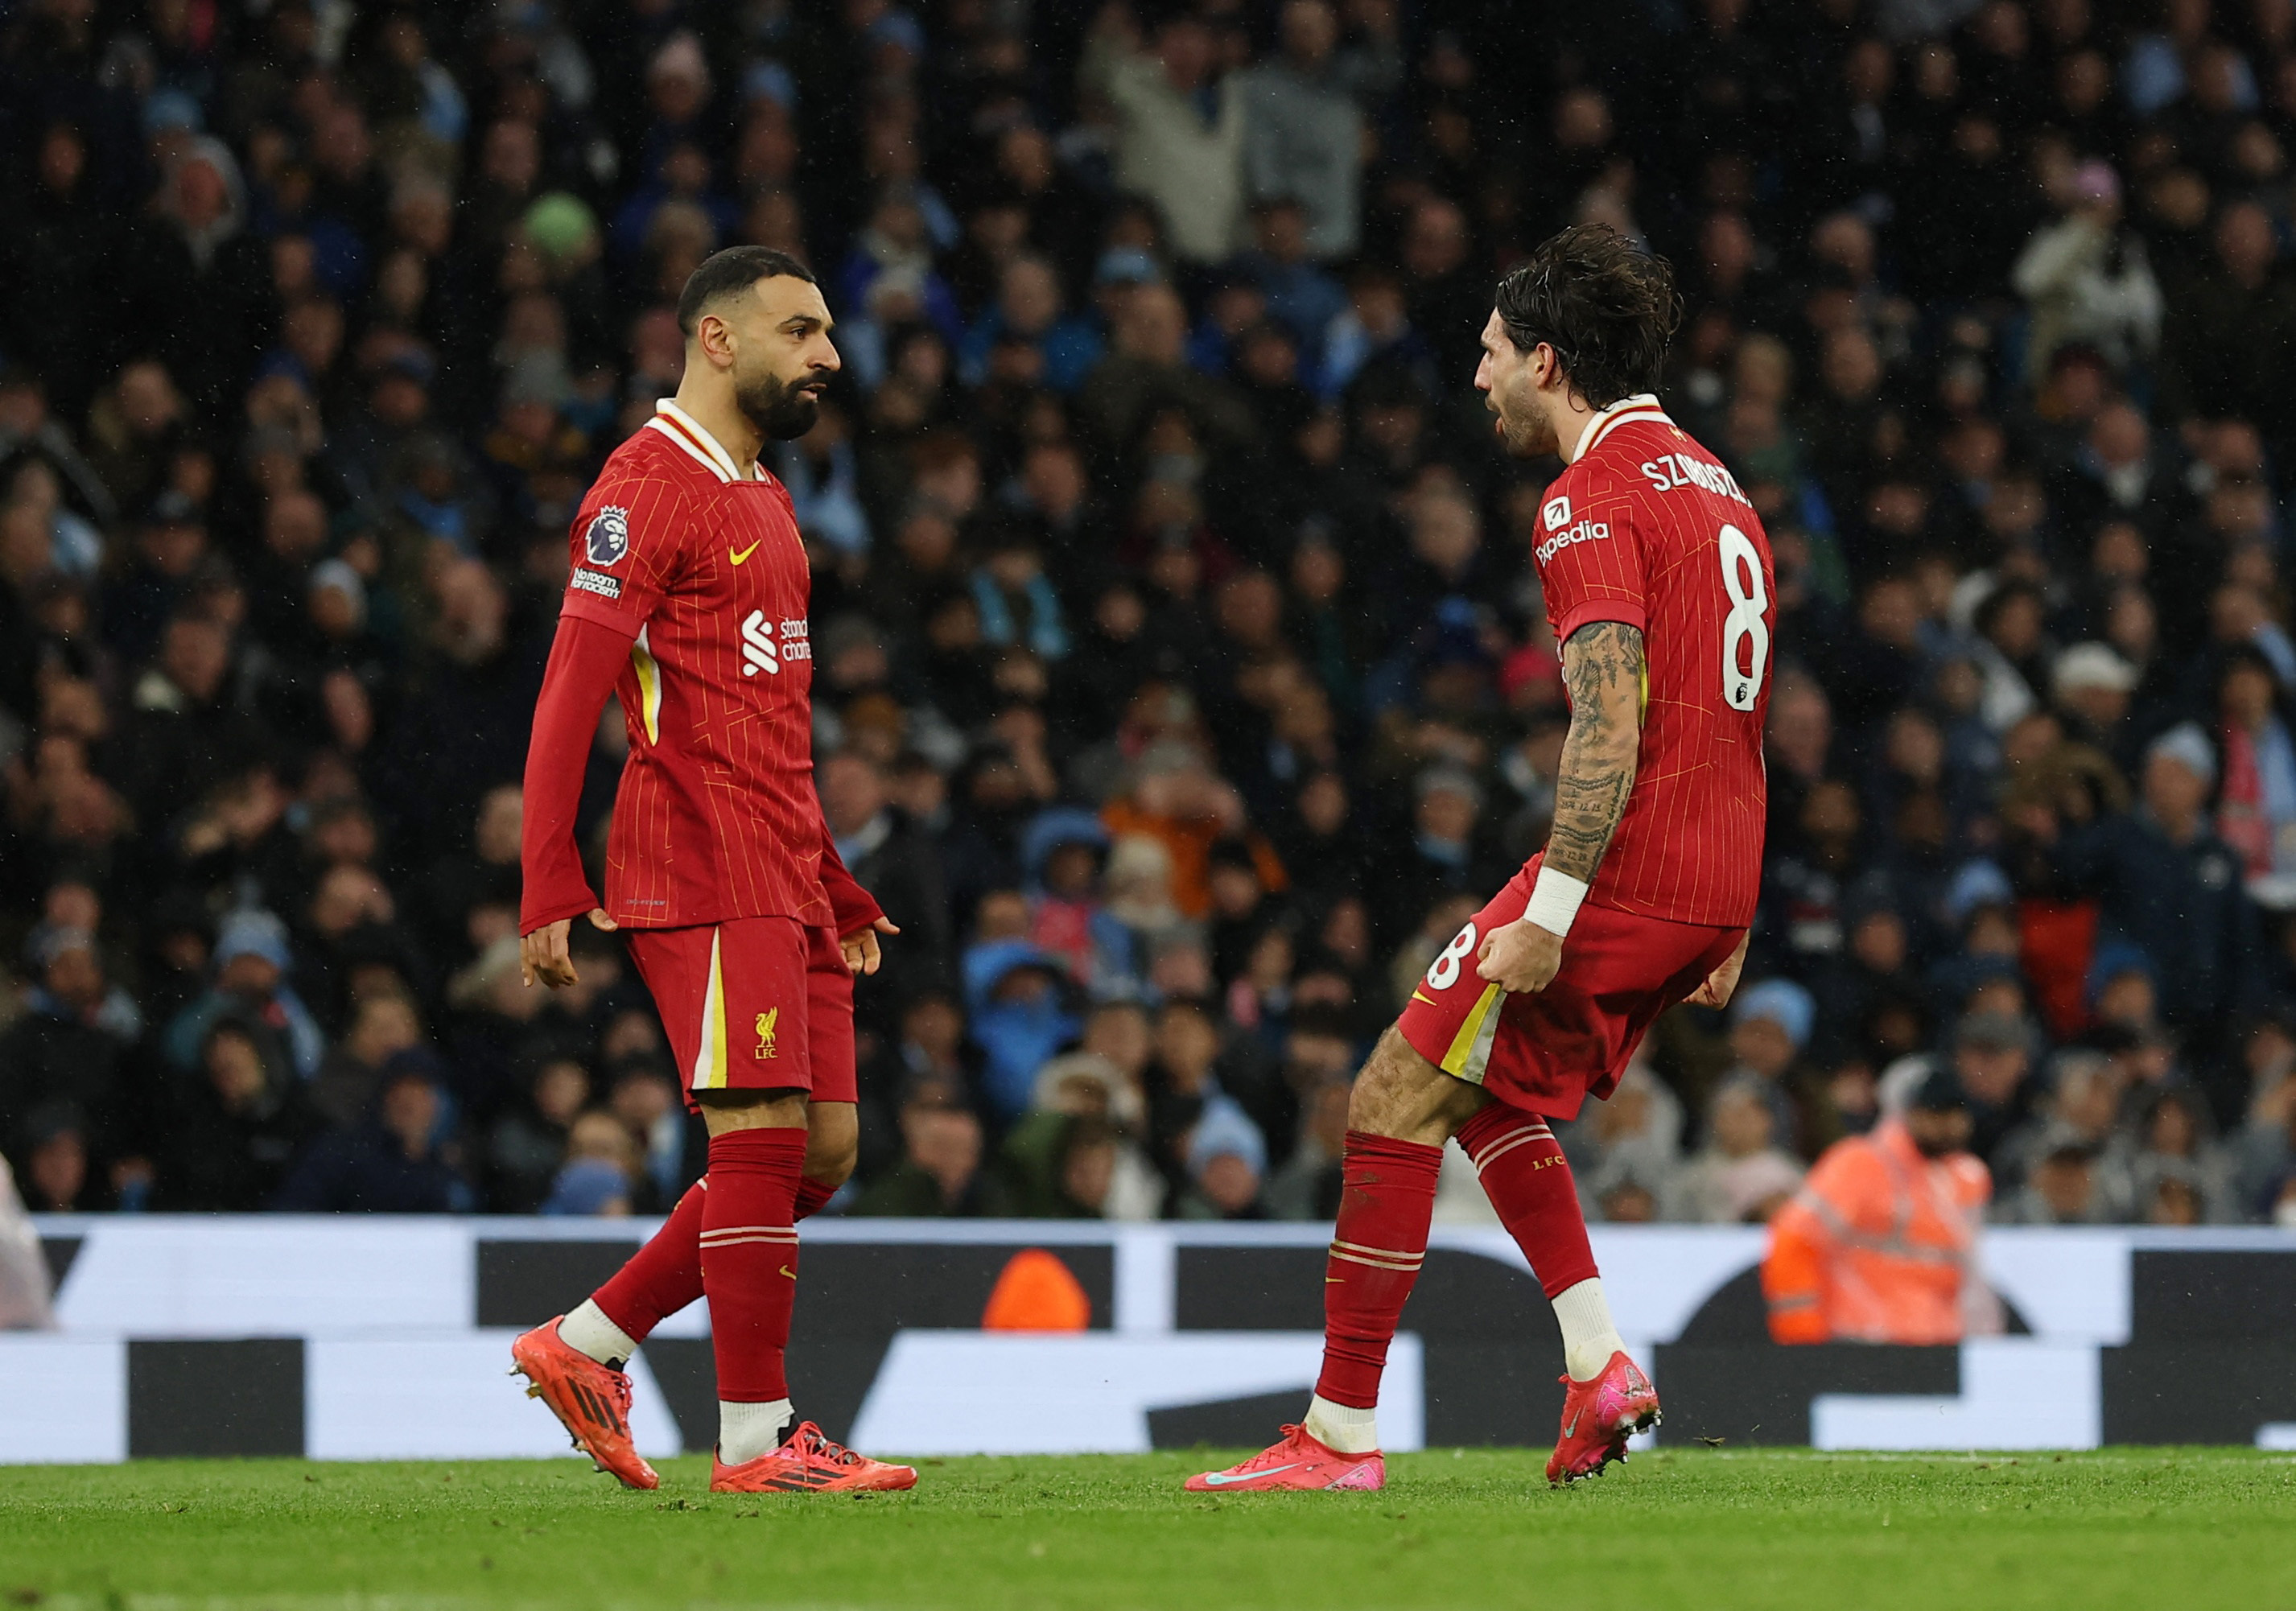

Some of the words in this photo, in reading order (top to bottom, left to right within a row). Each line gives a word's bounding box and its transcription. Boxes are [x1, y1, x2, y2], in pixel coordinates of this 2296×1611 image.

[1641, 452, 1753, 509] SZOBOSZL
[1535, 519, 1610, 569] Expedia
[575, 567, 587, 580] No
[587, 571, 617, 588] room
[1718, 524, 1769, 711] 8
[1427, 921, 1477, 990] 8
[1532, 1156, 1565, 1171] LFC
